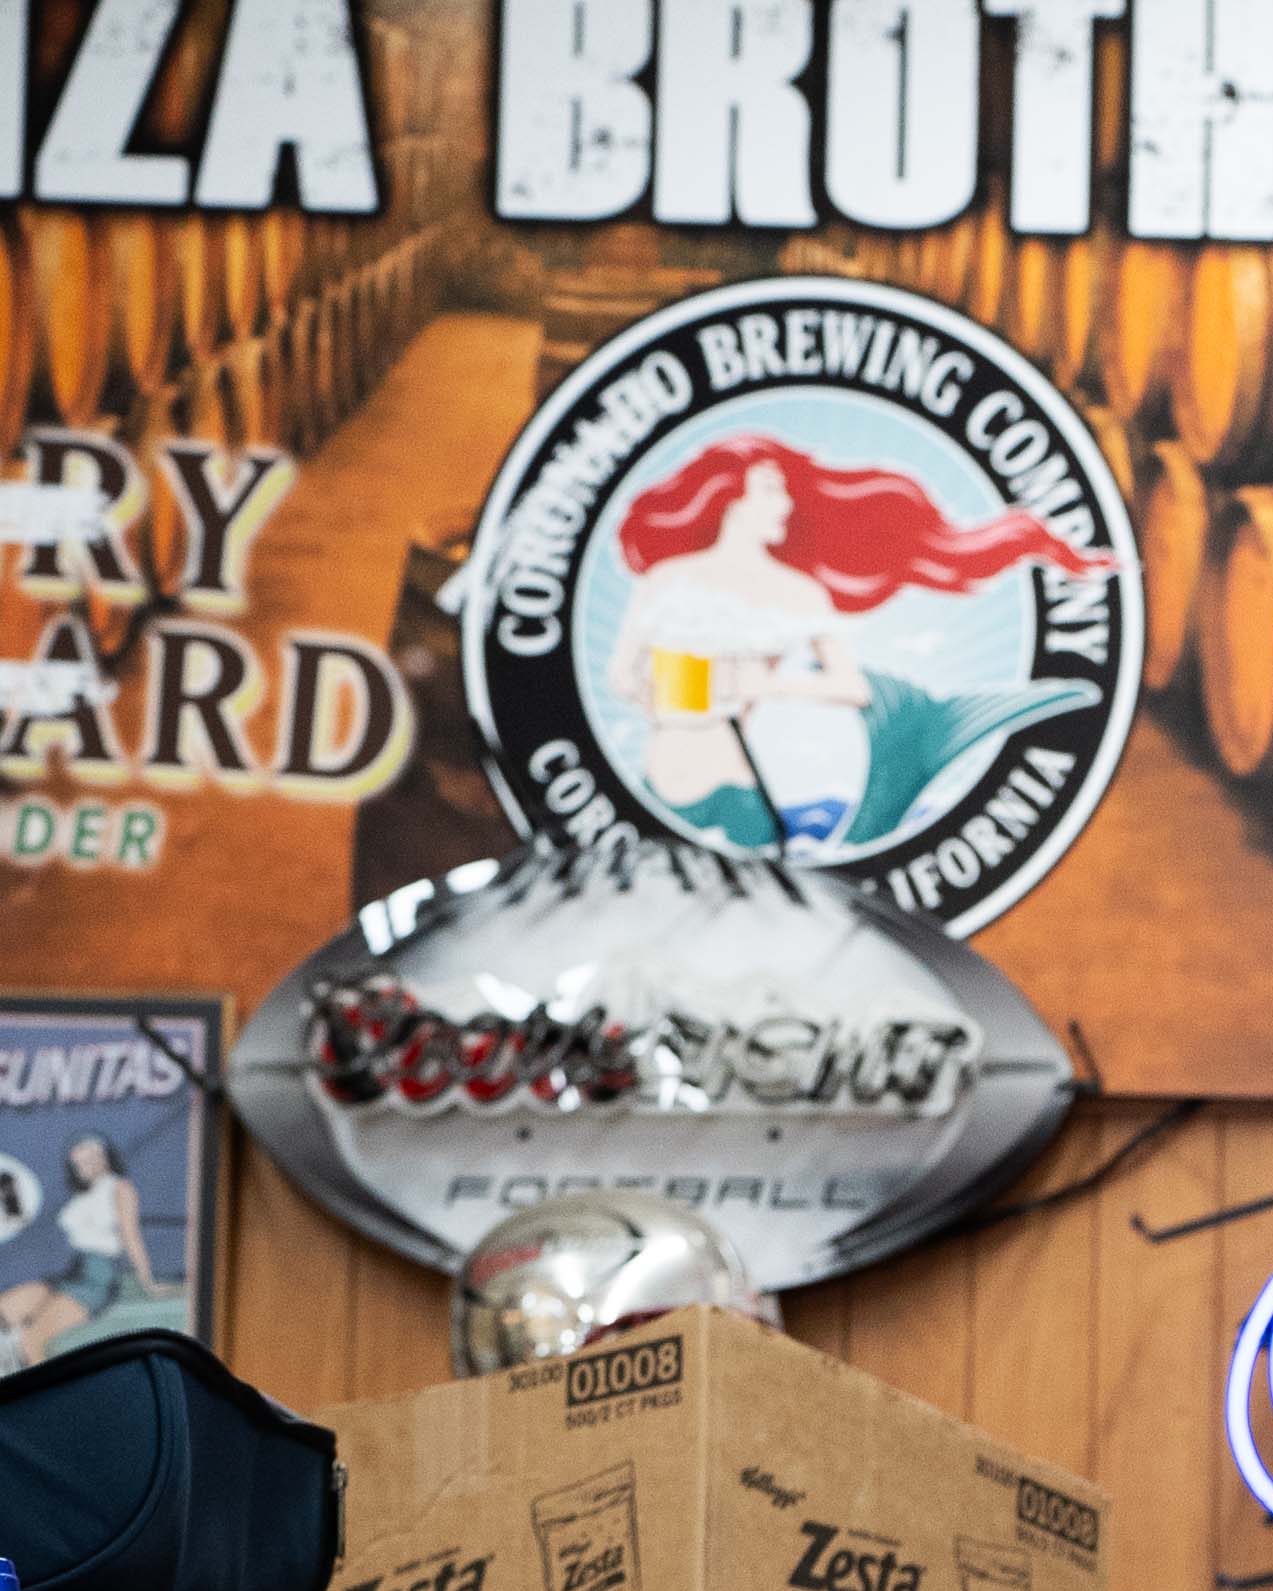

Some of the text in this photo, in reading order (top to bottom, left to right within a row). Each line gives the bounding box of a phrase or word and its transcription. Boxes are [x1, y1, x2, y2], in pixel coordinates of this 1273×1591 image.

[0, 0, 380, 213] ZA
[498, 309, 1112, 665] CORONADO BREWING COMPNY
[888, 743, 1077, 910] IFORNIA
[570, 1340, 680, 1402] 01008
